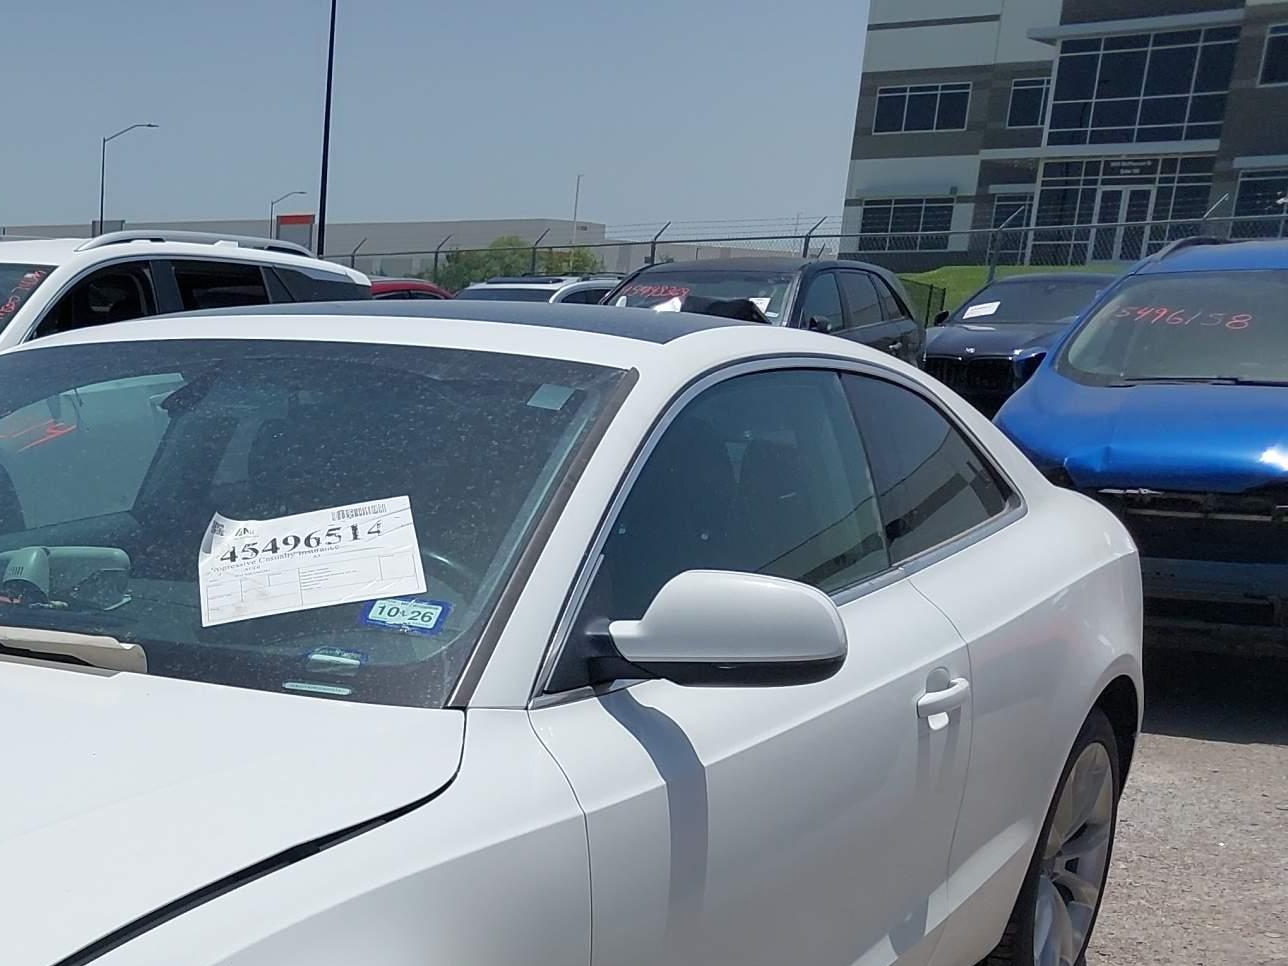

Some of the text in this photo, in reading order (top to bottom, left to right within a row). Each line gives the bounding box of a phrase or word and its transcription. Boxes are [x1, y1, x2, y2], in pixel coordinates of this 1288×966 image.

[219, 519, 384, 564] 45496514
[378, 603, 400, 618] 10
[407, 610, 434, 623] 26
